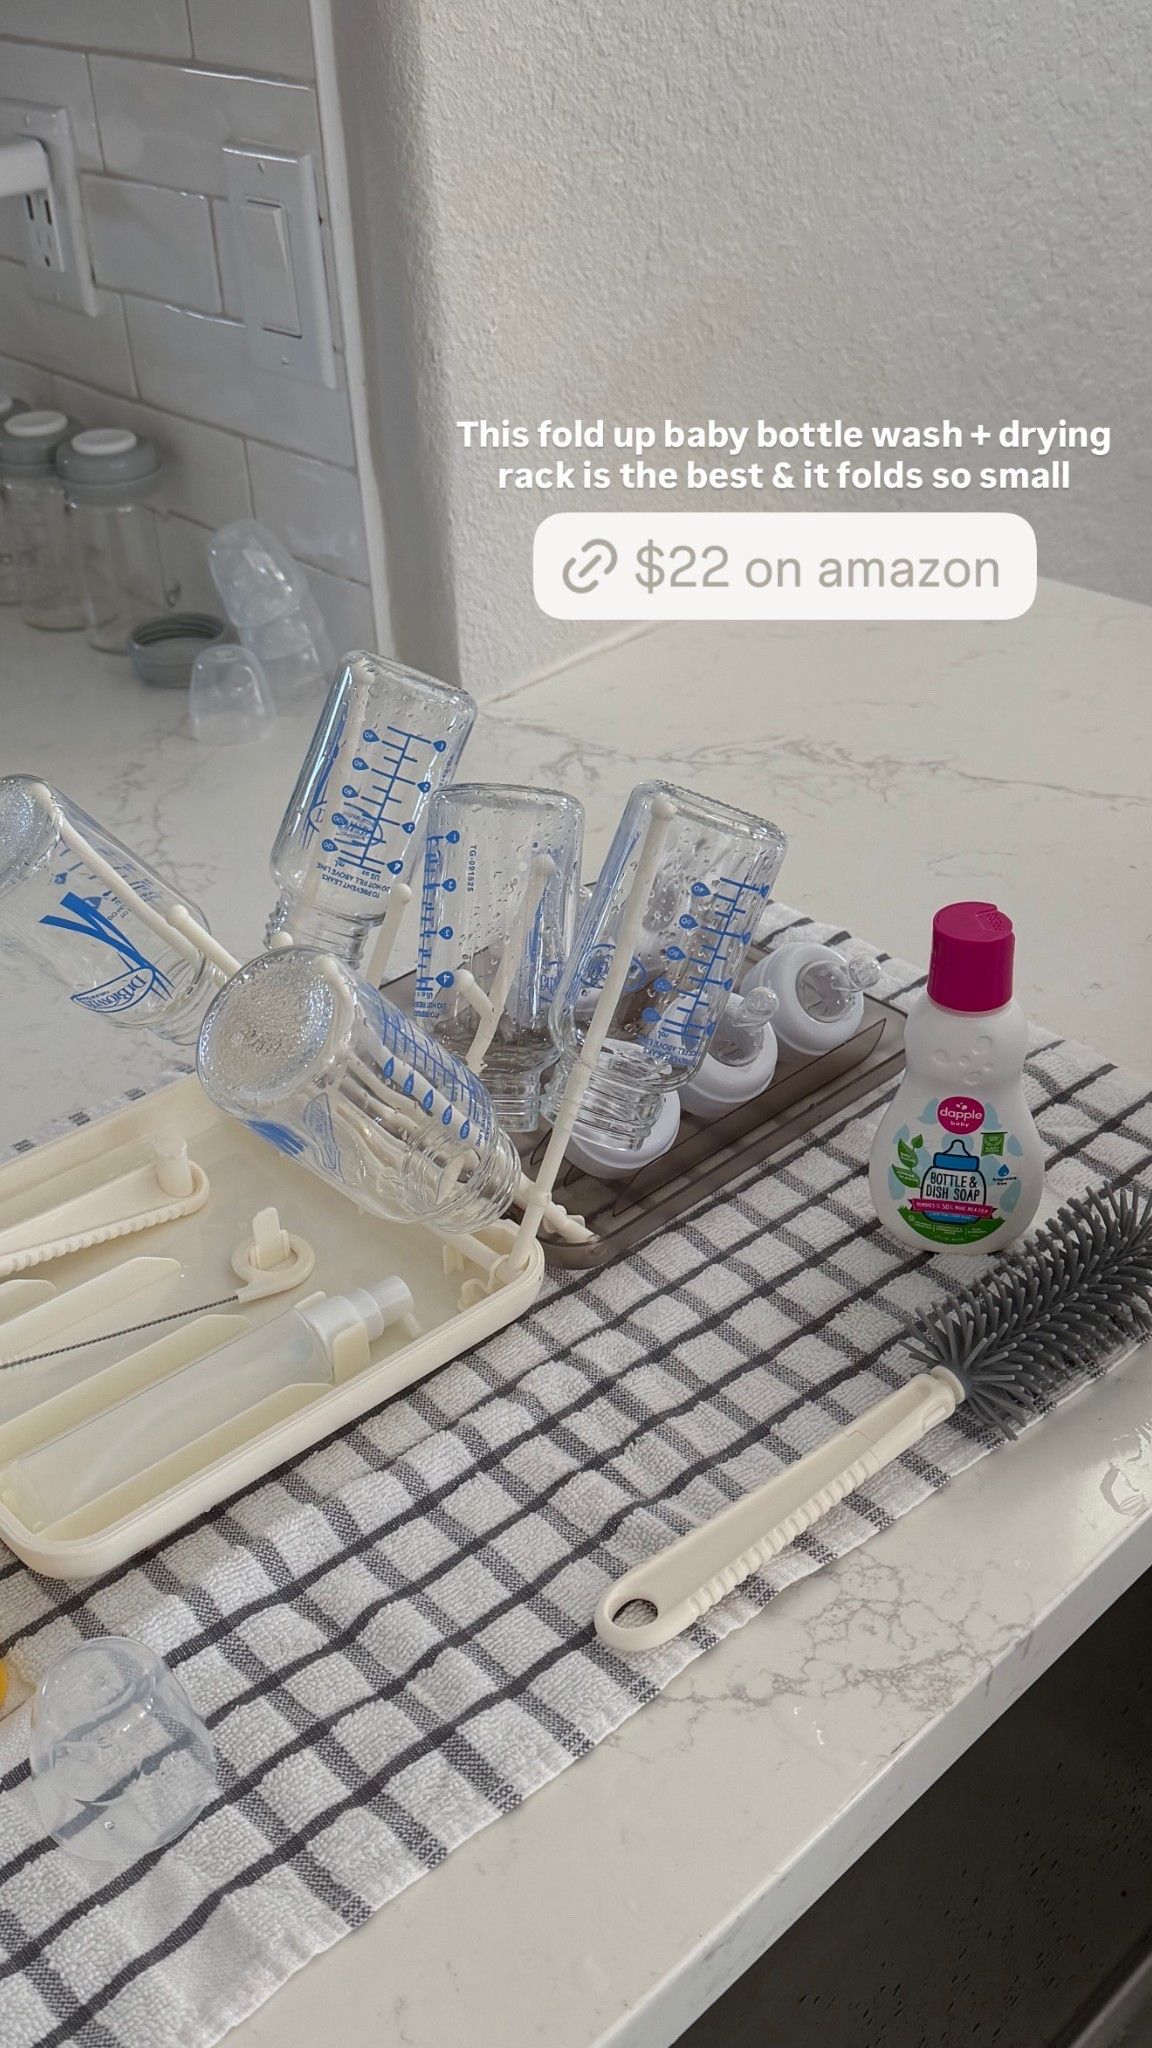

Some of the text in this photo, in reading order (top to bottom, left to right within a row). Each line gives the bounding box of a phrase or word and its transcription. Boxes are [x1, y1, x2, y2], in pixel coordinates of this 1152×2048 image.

[316, 862, 331, 873] LINE
[334, 859, 345, 868] mL
[331, 868, 354, 881] ABOVE
[370, 873, 380, 882] US
[321, 873, 381, 899] TO PREVENT LEAKS
[355, 876, 368, 886] FILL
[367, 880, 381, 890] NOT
[657, 1030, 669, 1039] mL
[655, 1041, 676, 1053] ABOVE
[940, 1107, 983, 1122] dapple
[950, 1120, 970, 1129] baby
[930, 1171, 967, 1189] BOTTLE
[969, 1175, 978, 1189] &
[925, 1184, 981, 1202] DISH SOAP
